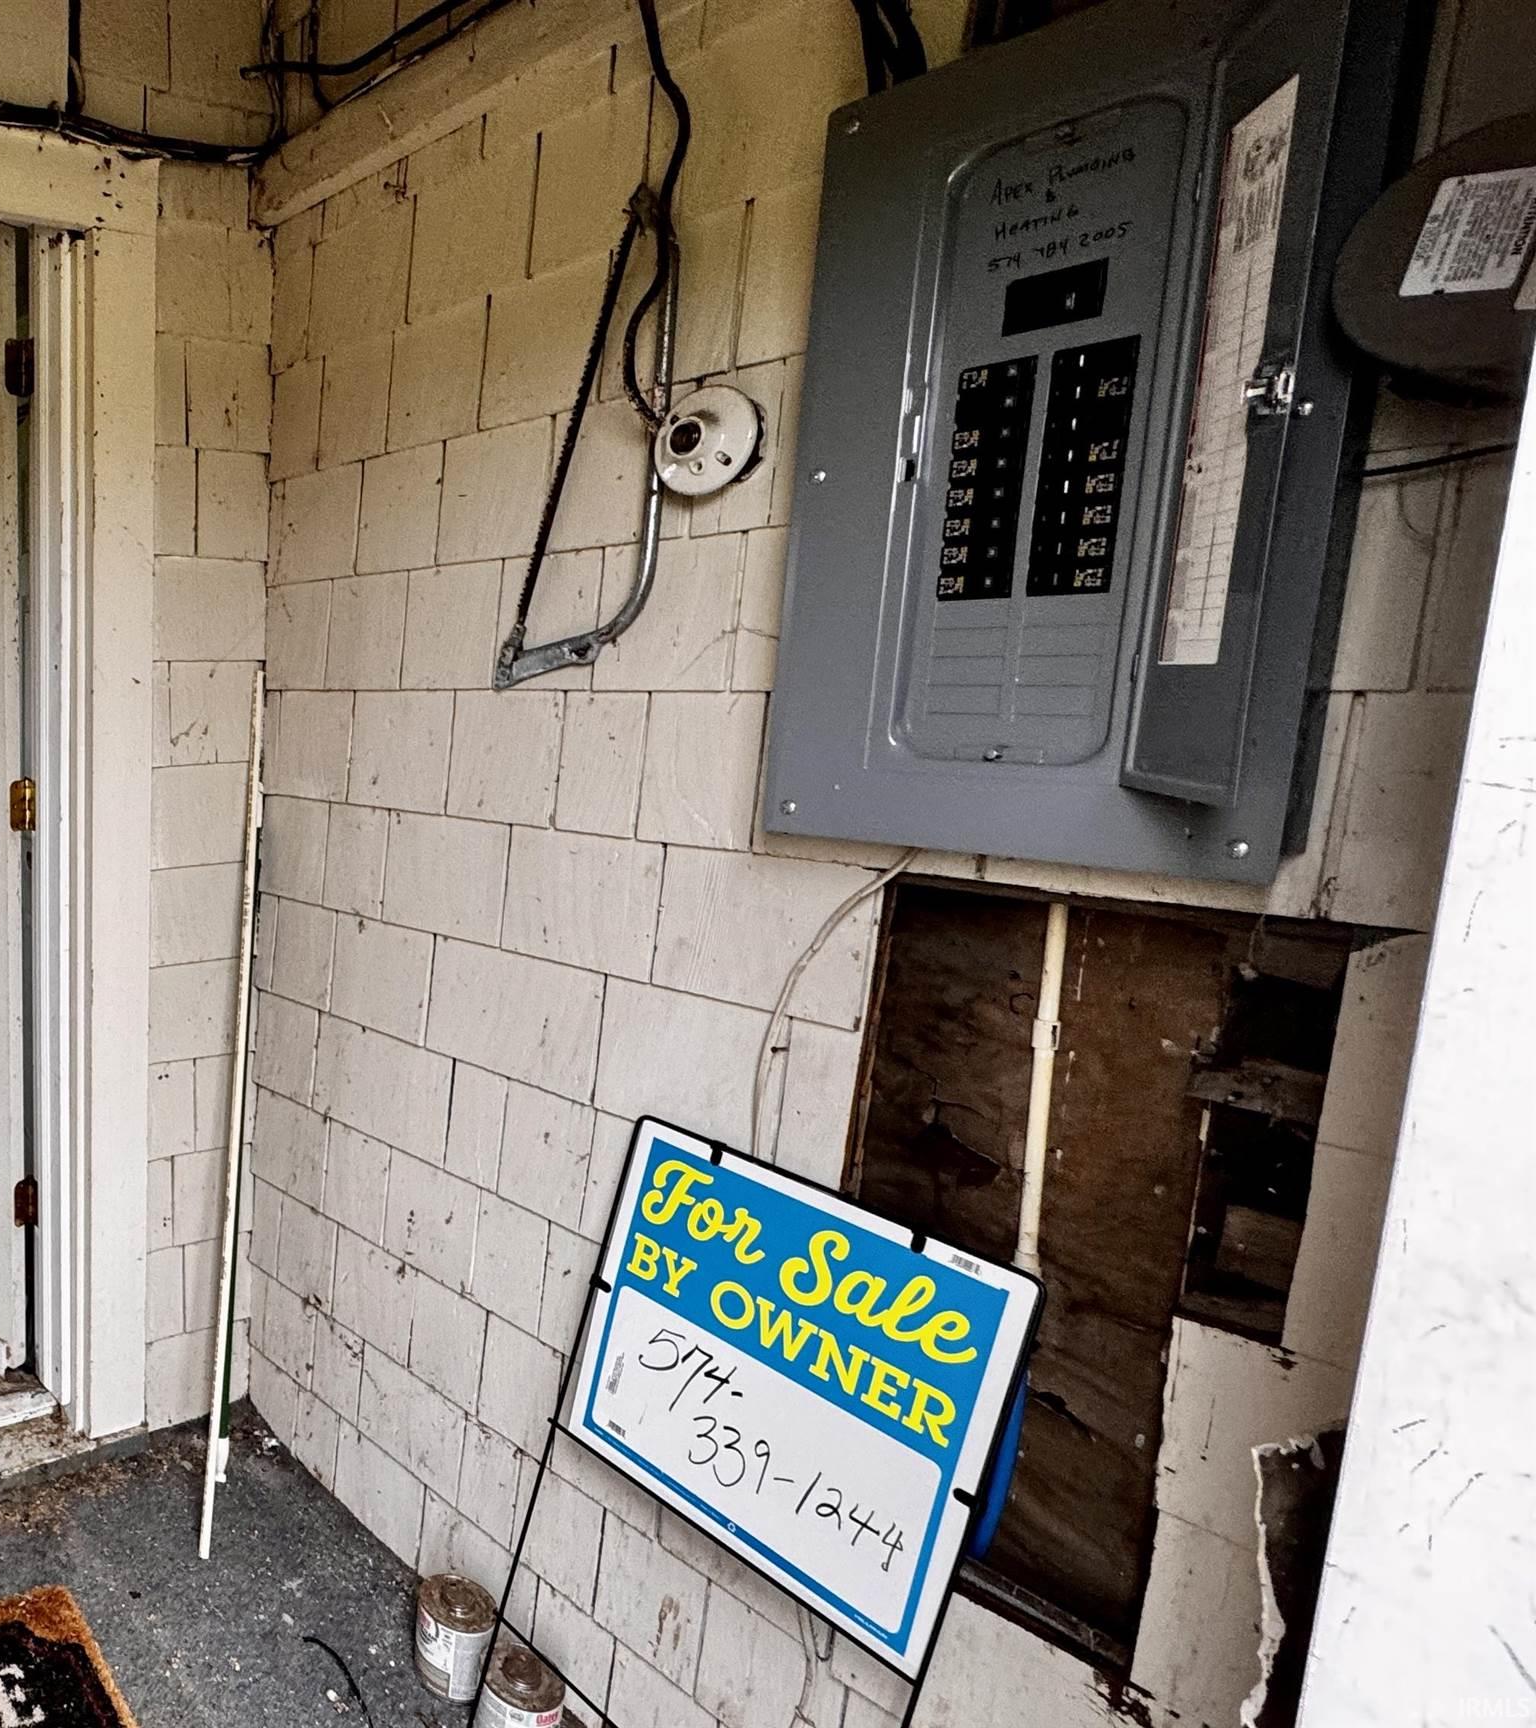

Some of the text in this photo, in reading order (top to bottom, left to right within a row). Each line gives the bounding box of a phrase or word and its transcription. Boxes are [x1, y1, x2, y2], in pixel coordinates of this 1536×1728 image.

[987, 252, 1021, 273] 574
[1078, 220, 1134, 247] 2005
[991, 178, 1034, 206] APEX
[641, 1159, 978, 1364] For Sale
[627, 1233, 957, 1448] BY OWNER
[638, 1328, 744, 1412] 574-
[688, 1416, 904, 1572] 339-1244
